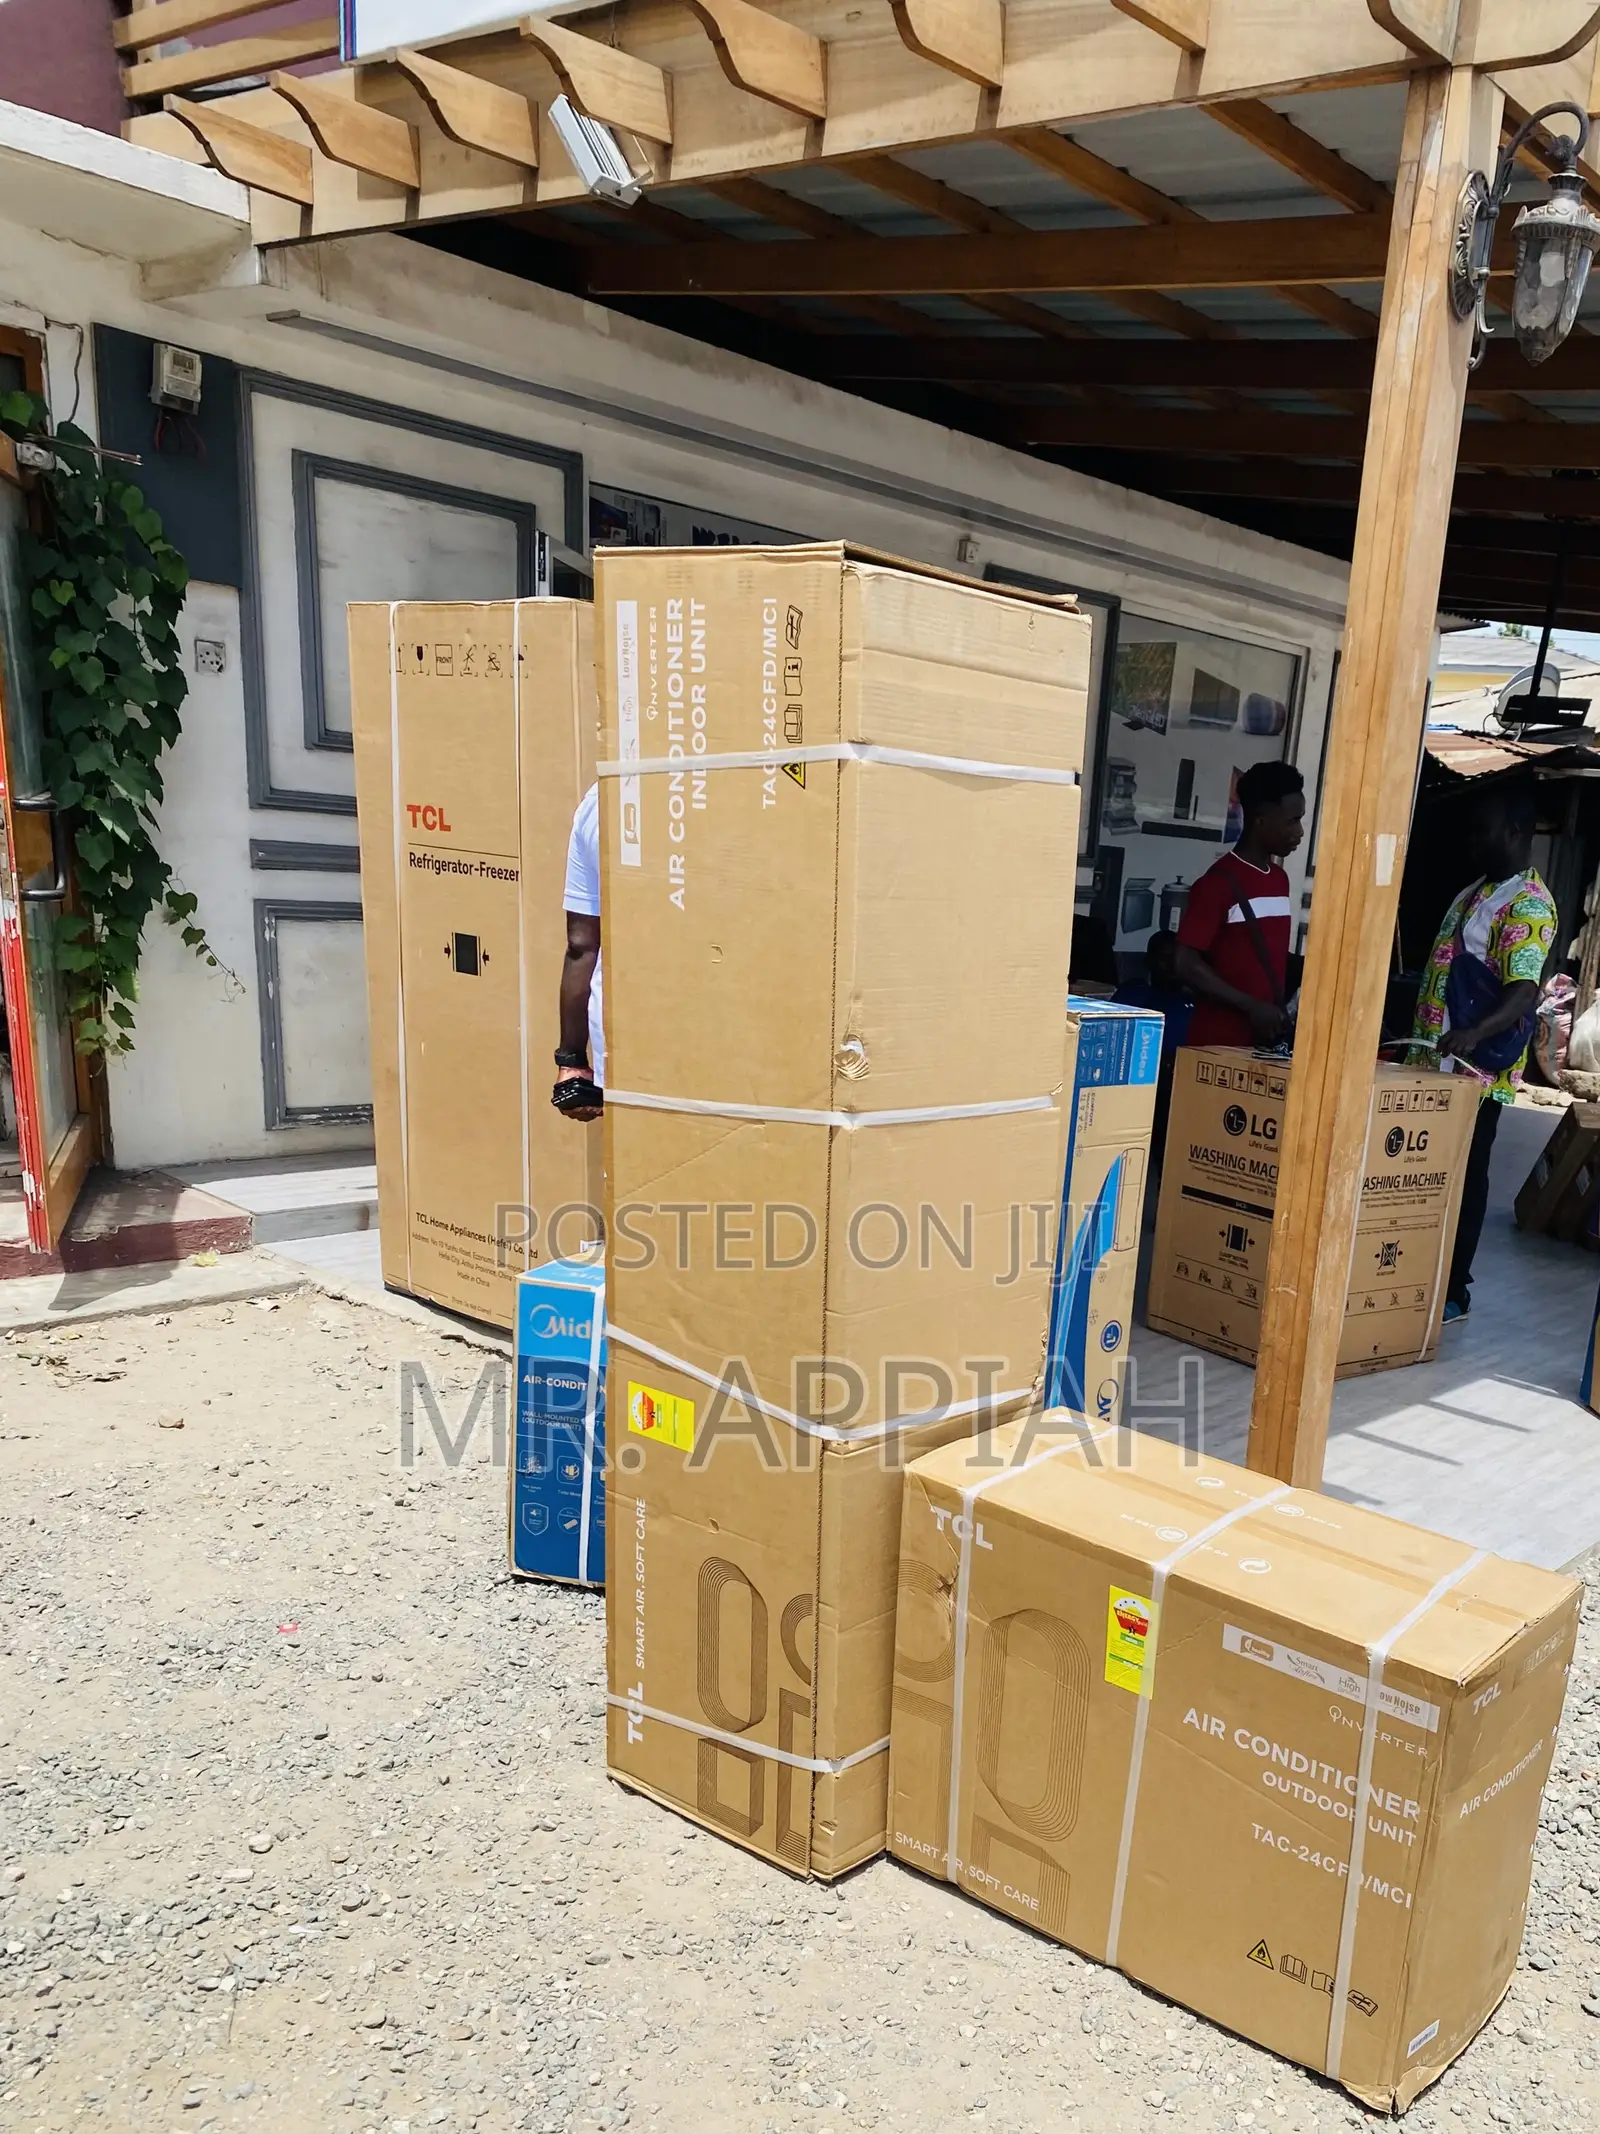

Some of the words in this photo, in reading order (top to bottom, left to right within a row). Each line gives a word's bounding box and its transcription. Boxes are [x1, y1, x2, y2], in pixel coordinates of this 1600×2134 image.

[690, 597, 707, 673] UNIT
[666, 597, 685, 843] CONDITIONER
[406, 804, 451, 832] TCL
[409, 851, 520, 882] Refrigerator-Freezer
[669, 854, 685, 911] AIR
[1250, 1114, 1277, 1140] LG
[1406, 1130, 1429, 1151] LG
[1189, 1143, 1247, 1171] WASHING
[1362, 1174, 1401, 1191] ASHING
[1402, 1171, 1447, 1188] MACHINE
[415, 1211, 429, 1225] TCL
[430, 1216, 449, 1231] Home
[450, 1222, 486, 1243] Appliances
[529, 1249, 538, 1259] td
[636, 1497, 646, 1540] CARE
[929, 1505, 994, 1551] TCL
[635, 1619, 645, 1670] SMART
[1338, 1676, 1360, 1693] High
[1379, 1691, 1393, 1703] ow
[1393, 1695, 1421, 1714] Noise
[1473, 1682, 1502, 1716] TCL
[628, 1681, 644, 1744] TCL
[1183, 1707, 1226, 1740] AIR
[1233, 1727, 1421, 1823] CONDITIONER
[1459, 1795, 1480, 1819] AIR
[1483, 1738, 1544, 1803] CONDITIONER
[1368, 1815, 1417, 1847] UNIT
[895, 1831, 940, 1859] SMART
[1003, 1885, 1040, 1911] CARE
